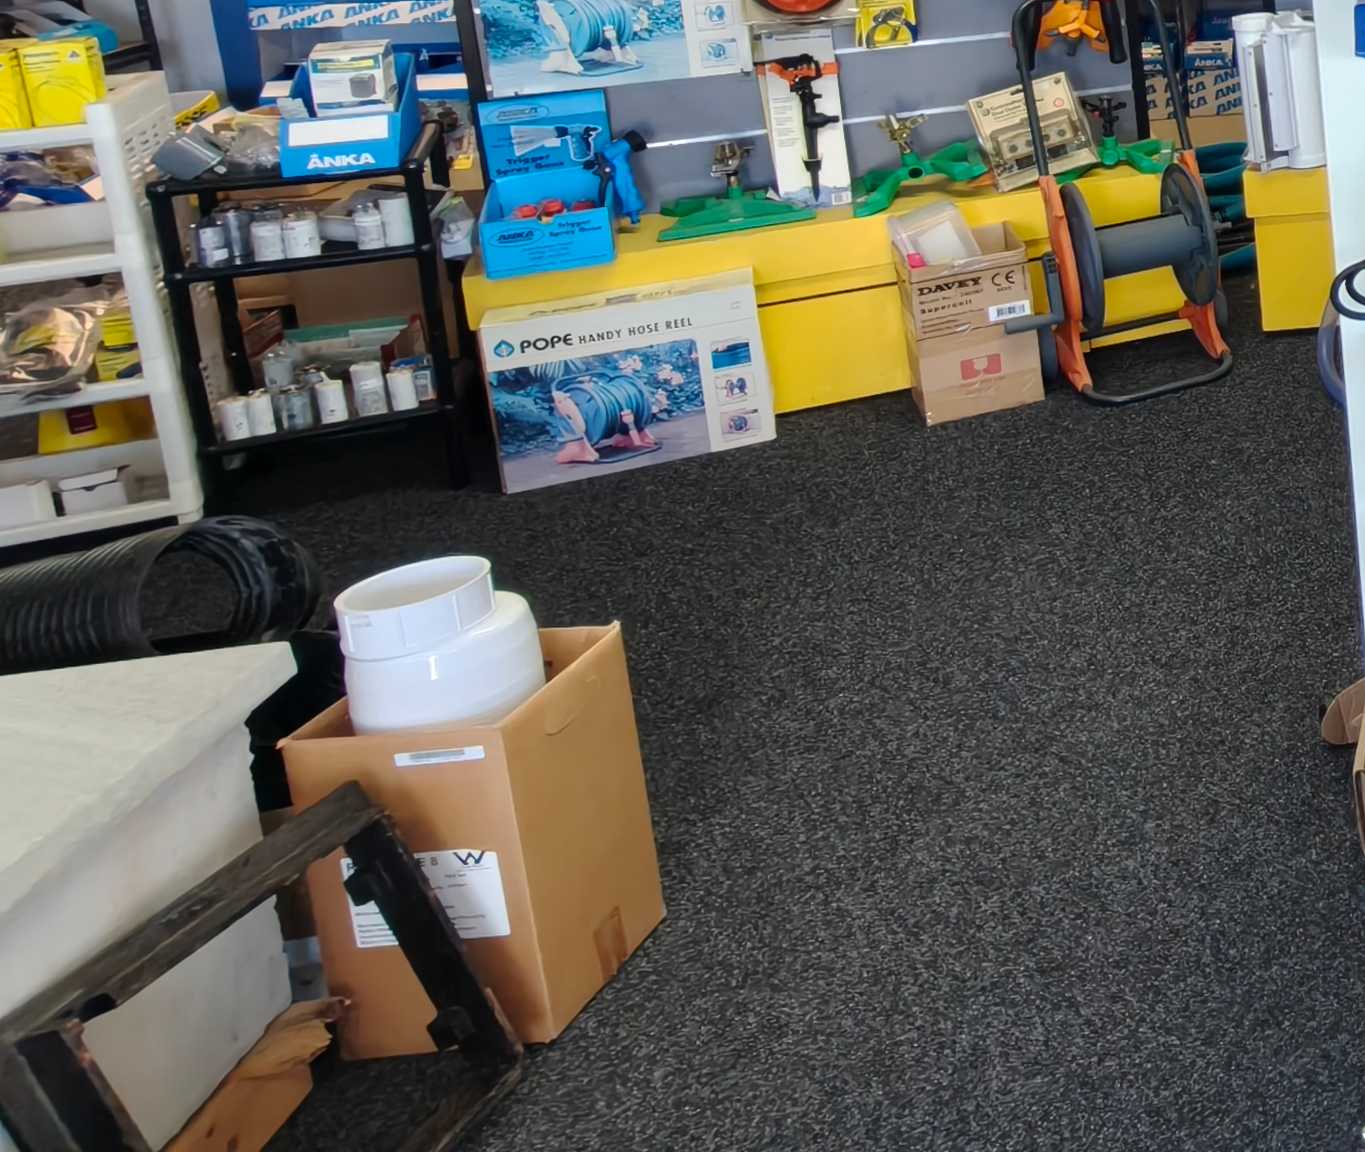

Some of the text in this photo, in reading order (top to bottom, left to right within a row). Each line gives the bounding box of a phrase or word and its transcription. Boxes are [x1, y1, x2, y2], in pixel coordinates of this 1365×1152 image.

[307, 152, 375, 169] ANKA
[918, 276, 982, 296] DAVEY
[520, 316, 693, 354] POPE HANDY HOSE REEL
